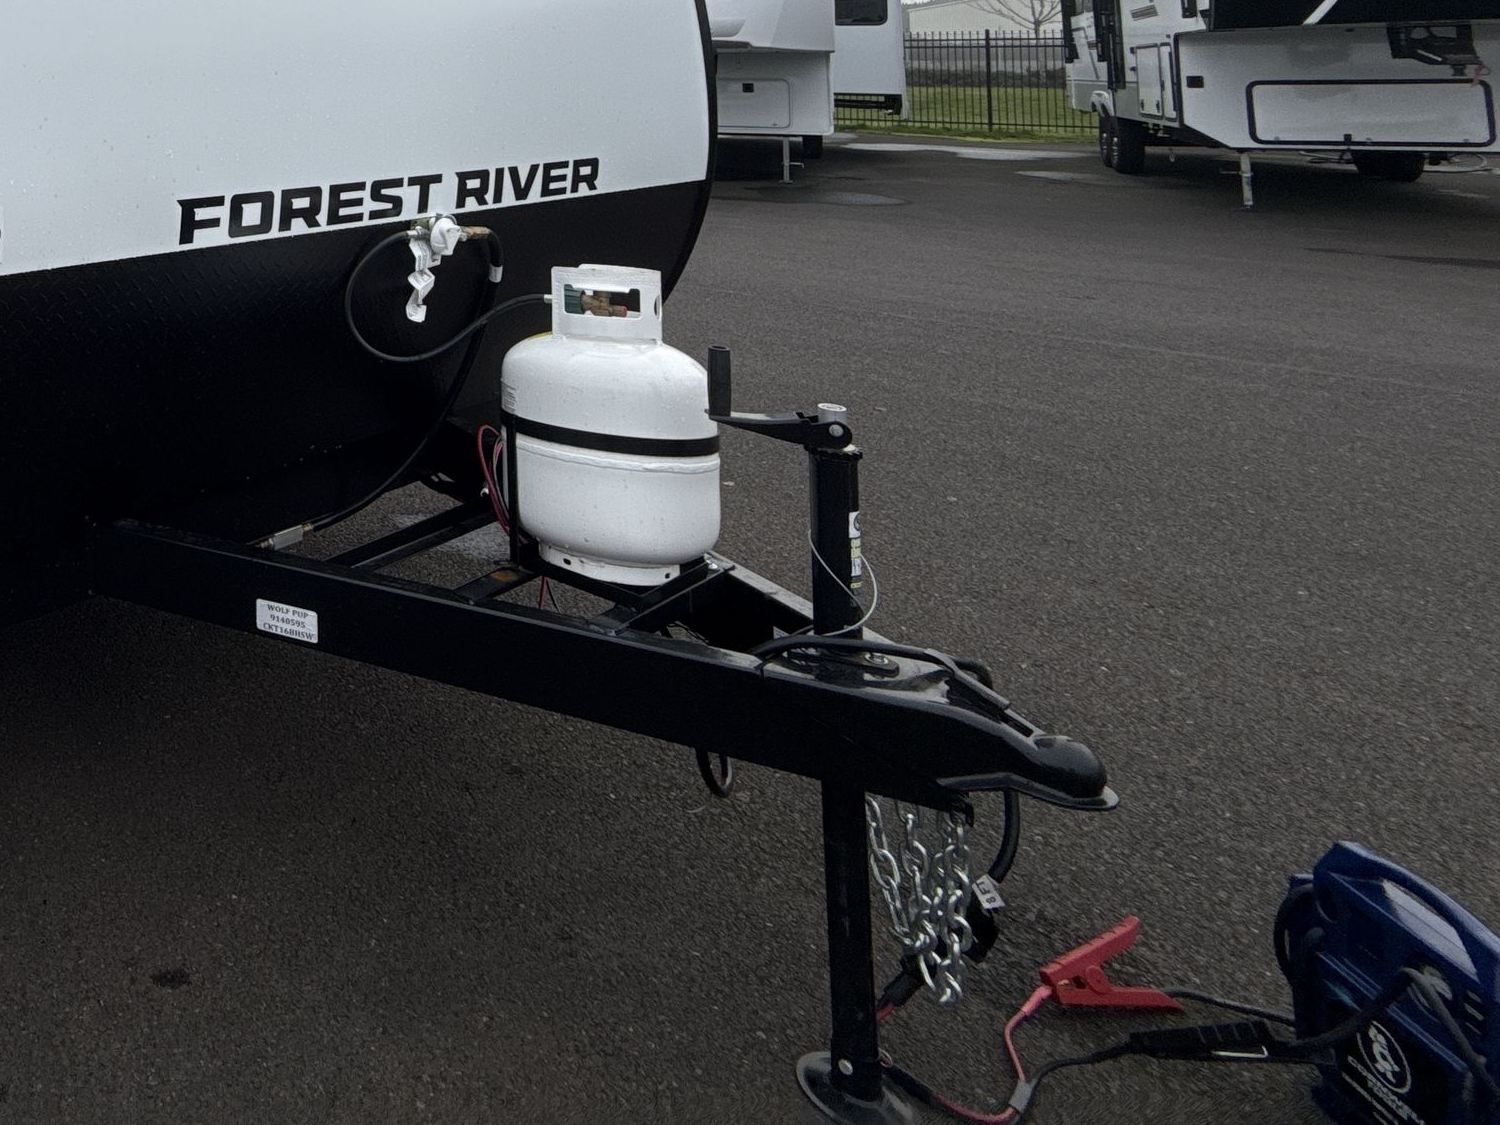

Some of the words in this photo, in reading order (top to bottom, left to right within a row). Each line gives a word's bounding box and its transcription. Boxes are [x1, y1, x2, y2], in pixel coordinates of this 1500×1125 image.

[176, 173, 443, 246] FOREST
[455, 157, 600, 210] RIVER
[267, 604, 290, 614] WOLF
[292, 609, 308, 619] PUP
